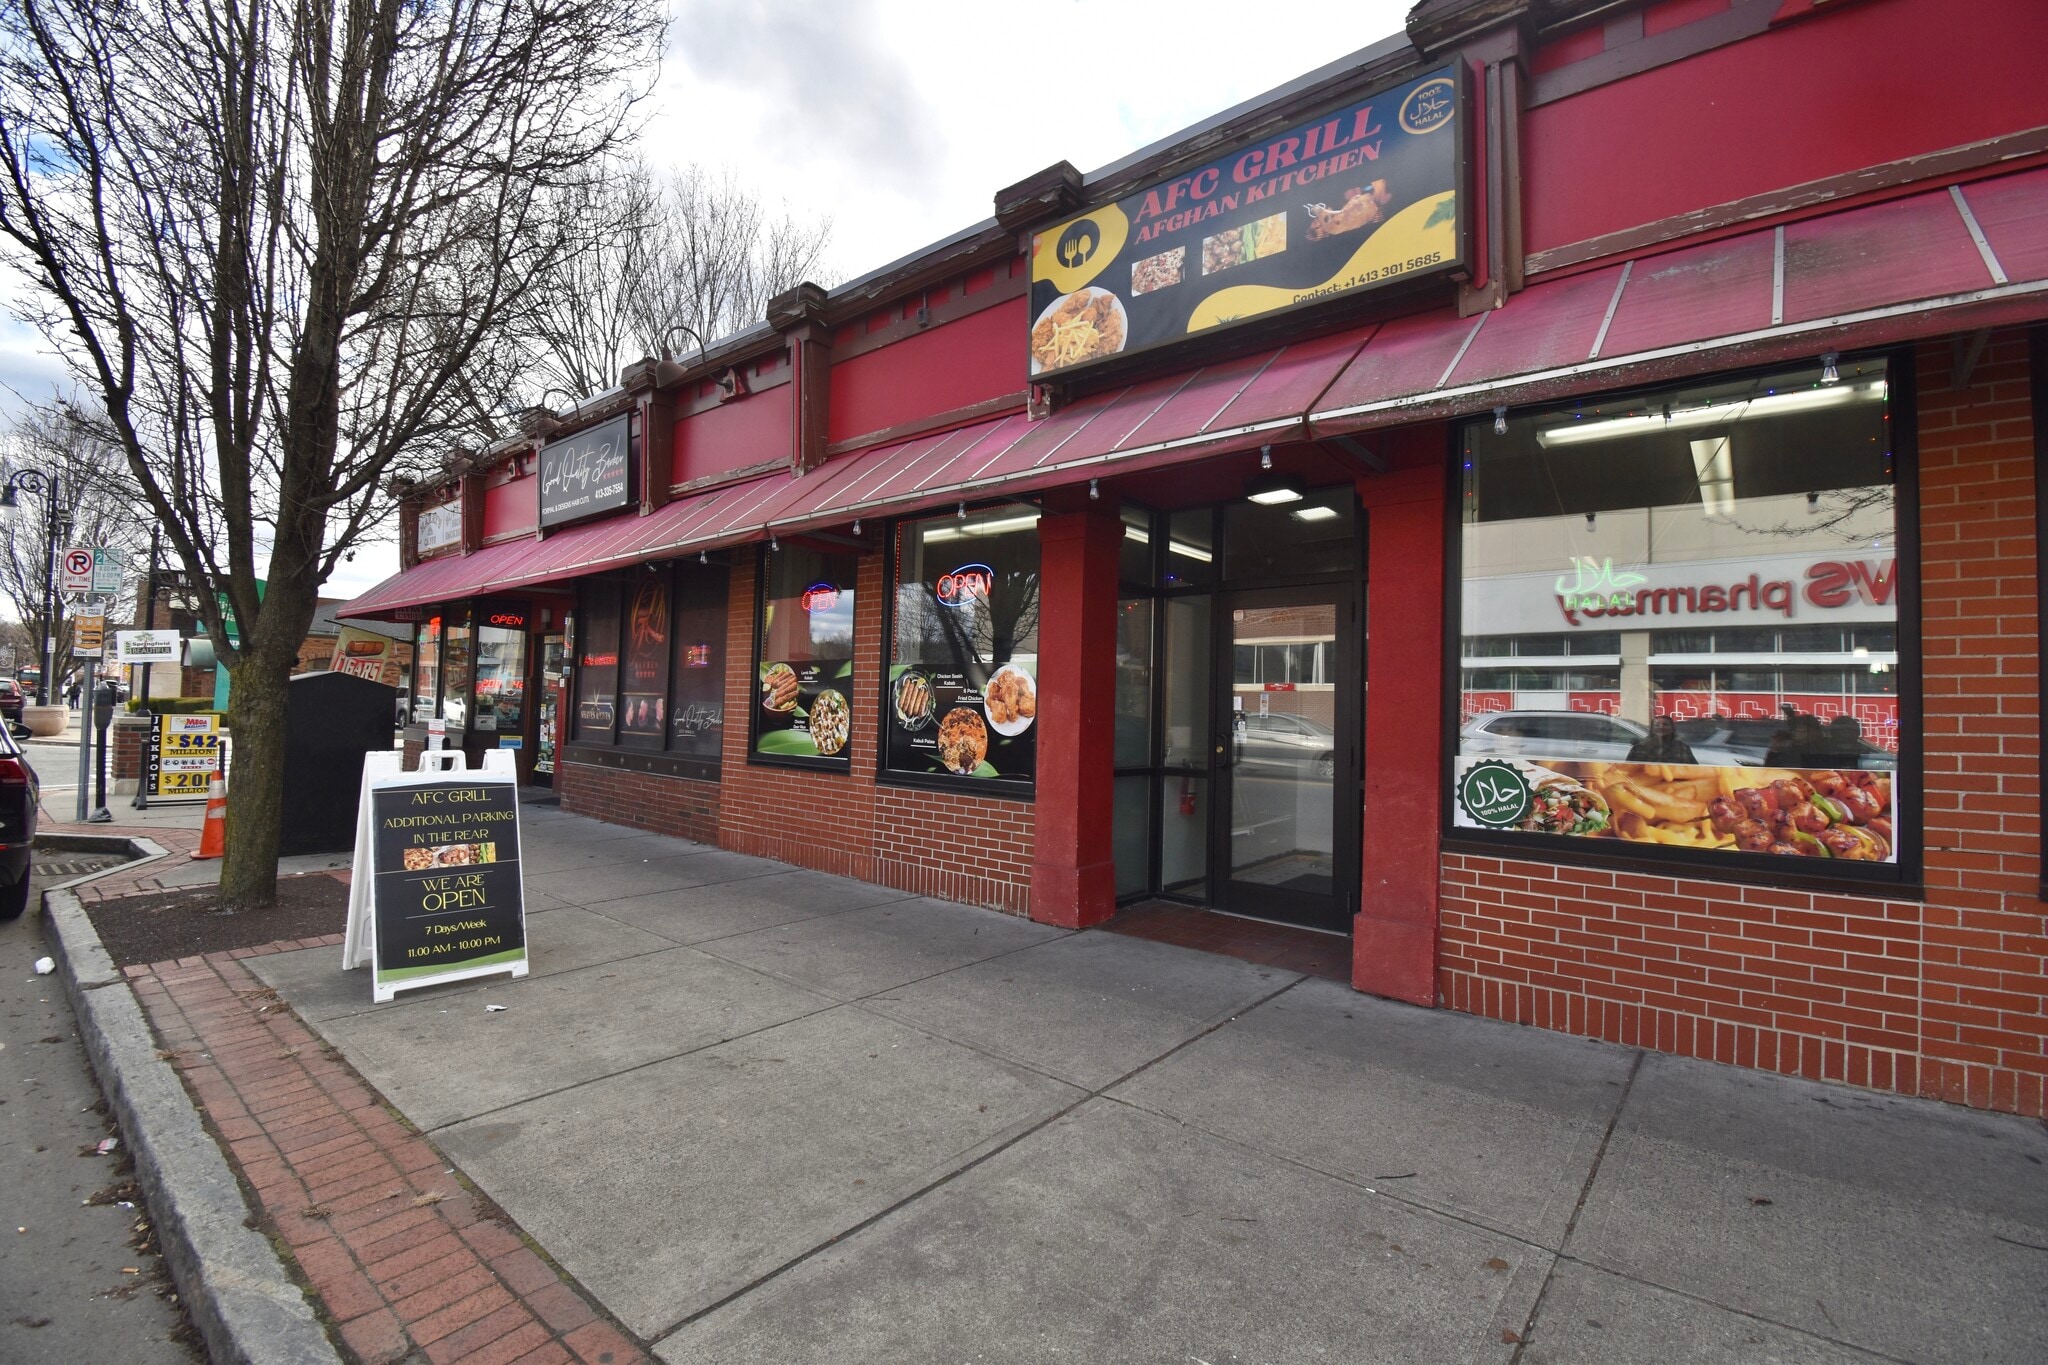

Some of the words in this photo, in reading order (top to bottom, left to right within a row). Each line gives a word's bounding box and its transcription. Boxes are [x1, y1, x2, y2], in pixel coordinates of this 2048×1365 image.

[1418, 85, 1442, 100] 100%
[1410, 97, 1450, 120] حلال
[1415, 112, 1444, 126] HALAL
[1134, 167, 1220, 224] AFC
[1232, 106, 1382, 183] GRILL
[1134, 191, 1241, 245] AFGHAN
[1244, 140, 1383, 205] KITCHEN
[1293, 283, 1341, 304] Contact:
[1344, 276, 1355, 289] +1
[1358, 270, 1379, 284] 413
[1381, 262, 1403, 277] 301
[1406, 251, 1441, 270] 5685
[542, 458, 562, 496] Good
[563, 444, 595, 493] Quality
[592, 434, 624, 484] Barber
[936, 571, 992, 598] OPEN
[1556, 558, 1648, 595] حلال
[802, 590, 837, 610] OPEN
[1565, 593, 1633, 608] HALAL
[490, 614, 523, 625] OPEN
[132, 641, 170, 649] Springfield
[333, 651, 381, 681] CIGARS
[179, 734, 218, 748] $42
[149, 716, 160, 790] JACKPOTS
[411, 791, 444, 805] AFC
[448, 789, 492, 803] GRILL
[1471, 775, 1521, 809] حلال
[383, 814, 460, 829] ADDITIONAL
[462, 810, 514, 824] PARKING
[1480, 806, 1498, 816] 100%
[1497, 803, 1519, 812] HALAL
[413, 833, 424, 844] IN
[427, 831, 451, 842] THE
[454, 829, 489, 840] REAR
[422, 877, 450, 892] WE
[454, 873, 484, 888] ARE
[422, 887, 486, 912] OPEN
[424, 926, 431, 935] 7
[434, 919, 487, 935] Days/Week
[408, 945, 430, 958] 11.00
[431, 943, 451, 956] AM
[459, 938, 482, 950] 10.00
[484, 935, 501, 946] PM
